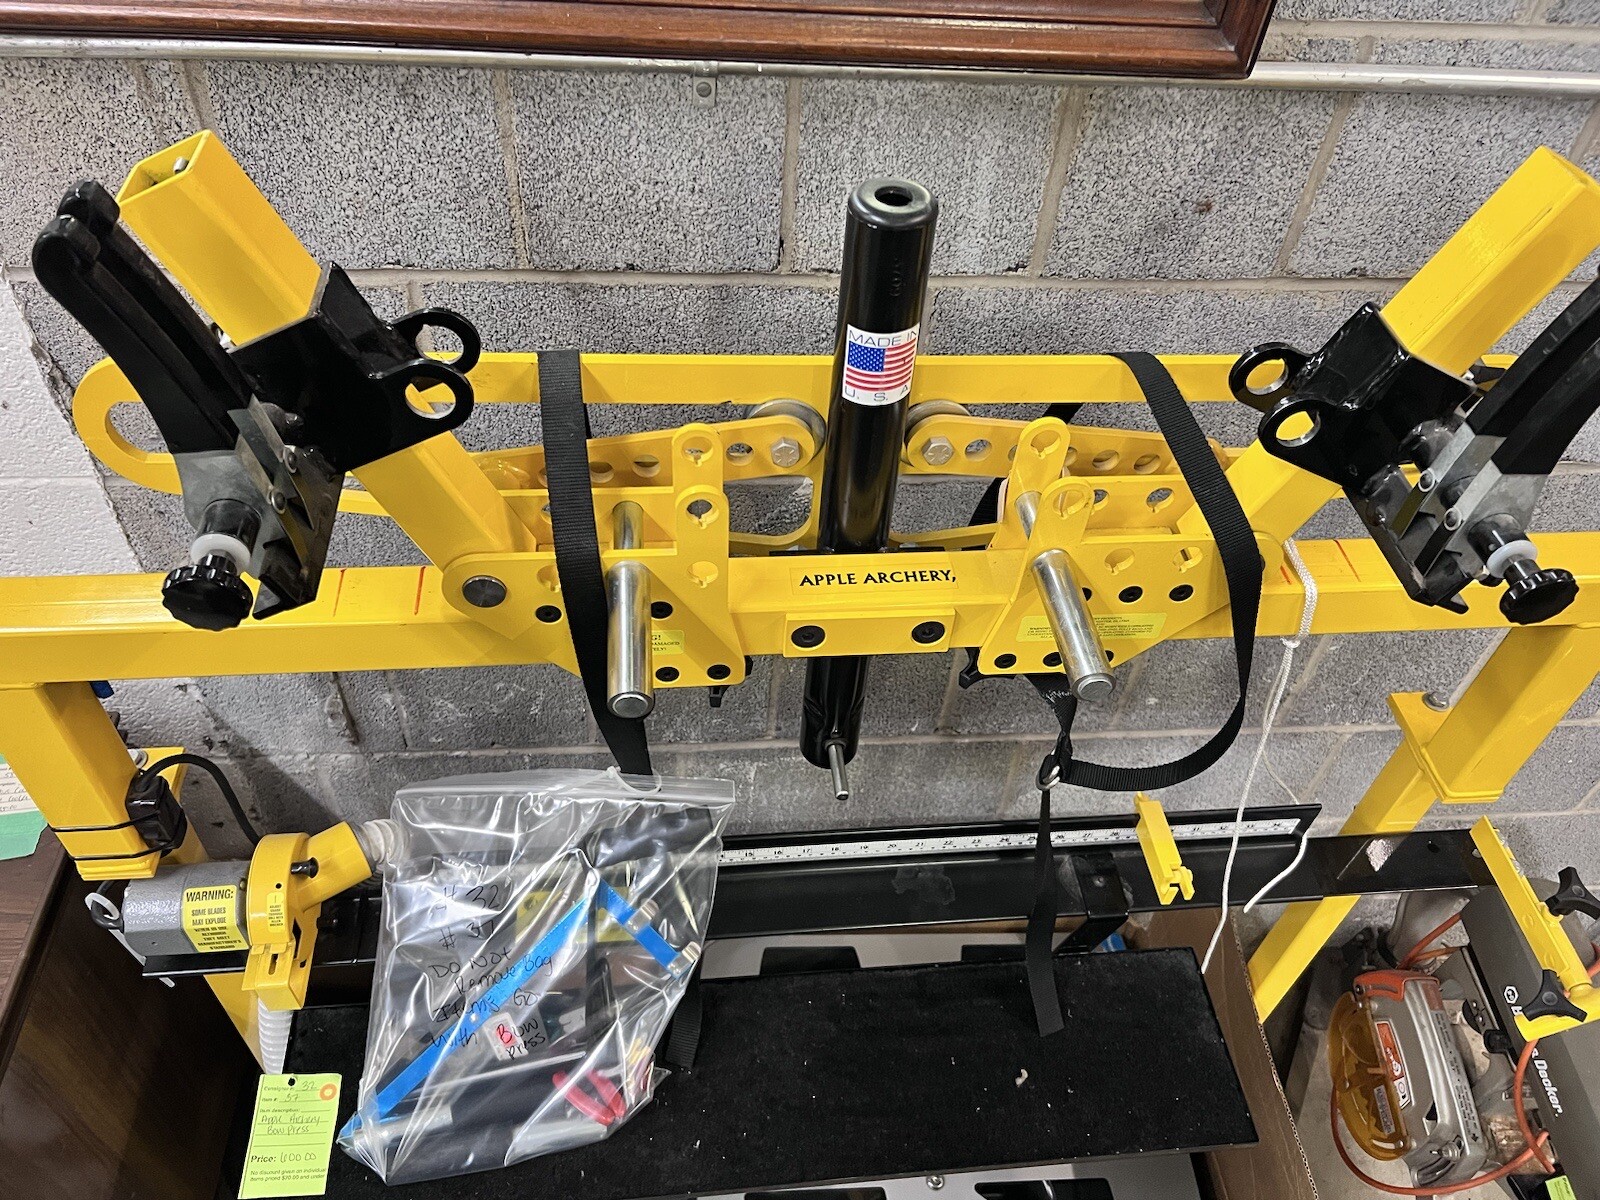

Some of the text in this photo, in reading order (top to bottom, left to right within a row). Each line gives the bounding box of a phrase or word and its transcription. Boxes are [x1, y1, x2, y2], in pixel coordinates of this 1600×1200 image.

[848, 330, 902, 348] MADE
[799, 569, 957, 587] APPLE ARCHERY,
[186, 889, 234, 902] WARNING:
[466, 884, 500, 909] 32
[191, 907, 226, 916] SOME BLADES
[205, 917, 226, 925] EXPLODE
[522, 953, 553, 977] Bag
[250, 1155, 277, 1163] Price:
